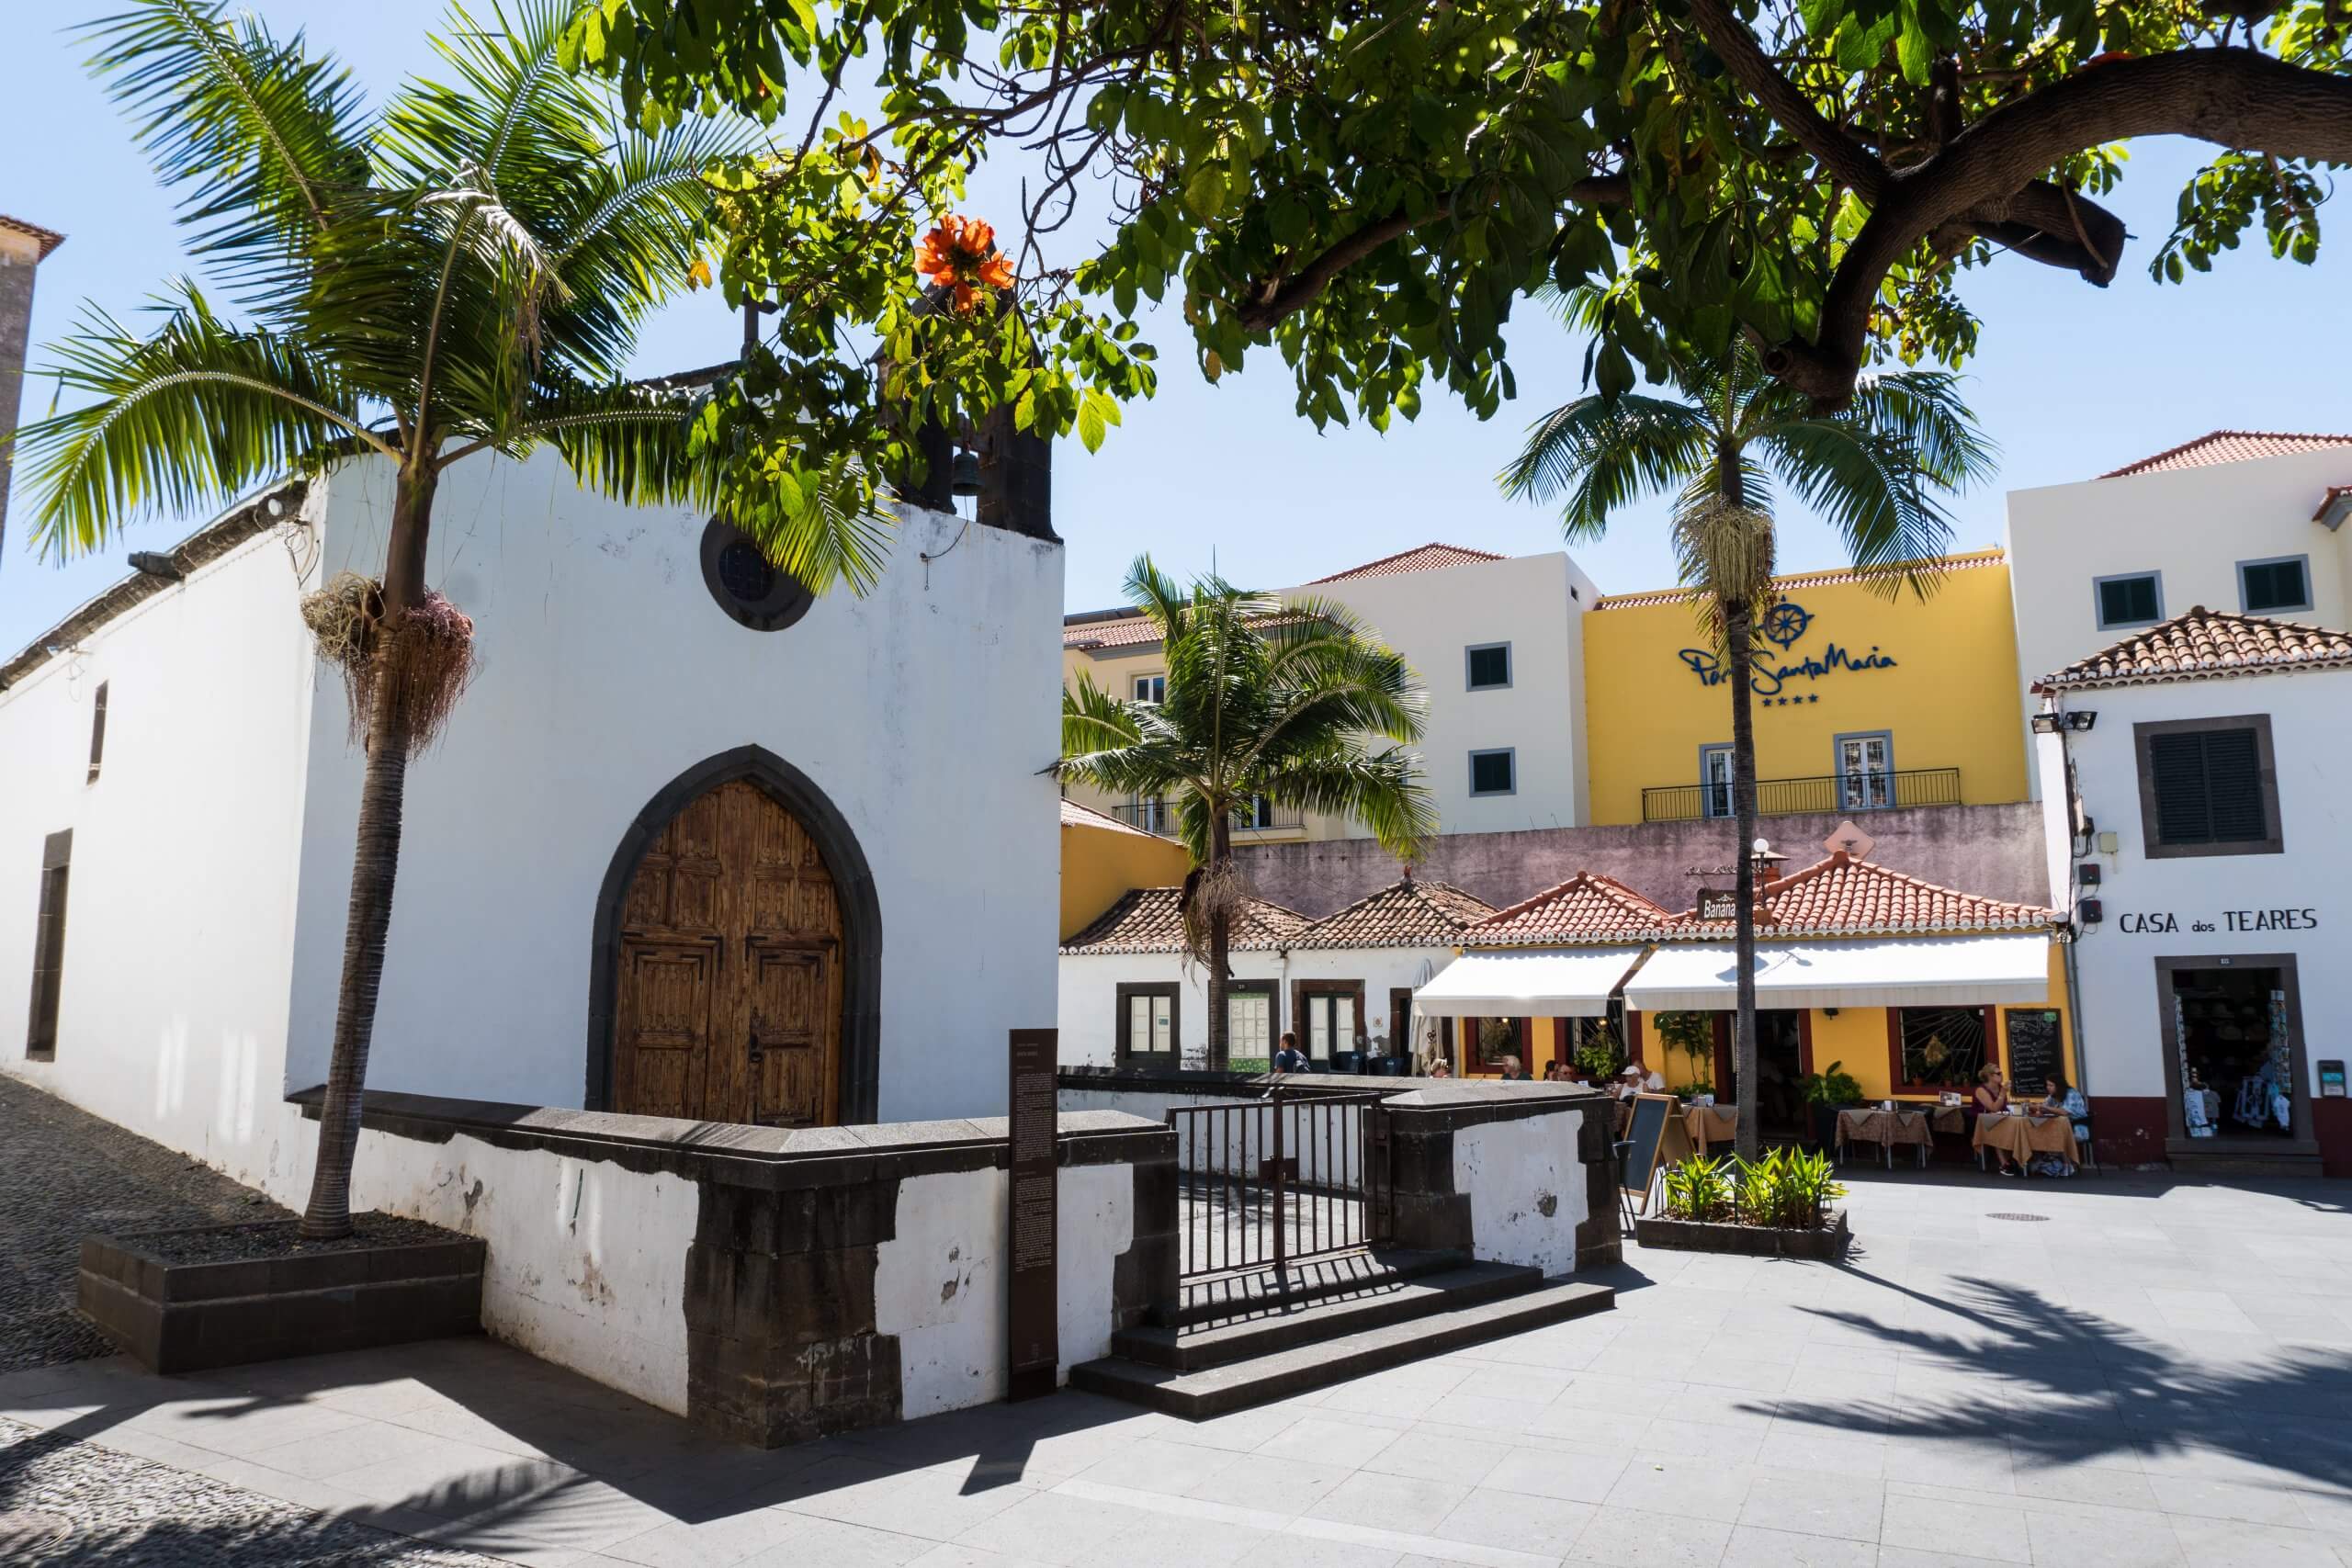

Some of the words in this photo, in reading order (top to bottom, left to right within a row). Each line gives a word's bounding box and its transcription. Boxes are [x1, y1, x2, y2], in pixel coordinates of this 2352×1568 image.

[1679, 649, 1736, 686] Por
[2119, 912, 2180, 934] CASA
[2191, 919, 2216, 933] dos
[2222, 908, 2319, 932] TEARES
